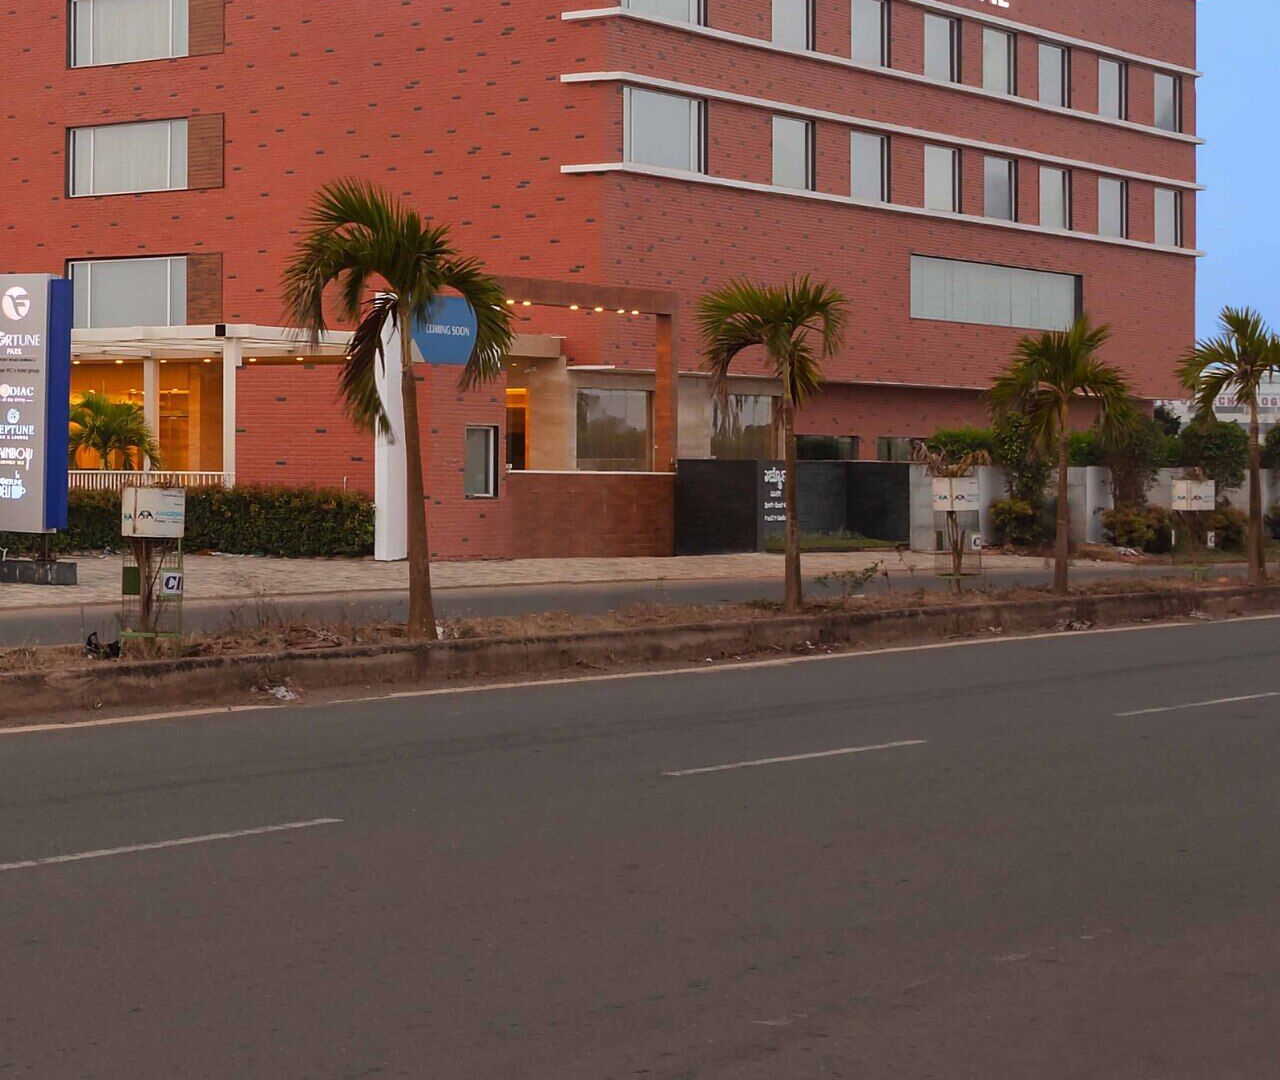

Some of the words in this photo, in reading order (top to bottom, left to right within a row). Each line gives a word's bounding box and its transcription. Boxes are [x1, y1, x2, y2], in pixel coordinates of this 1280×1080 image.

[426, 324, 450, 335] COMING
[452, 325, 470, 336] SOON
[6, 347, 23, 355] PARK
